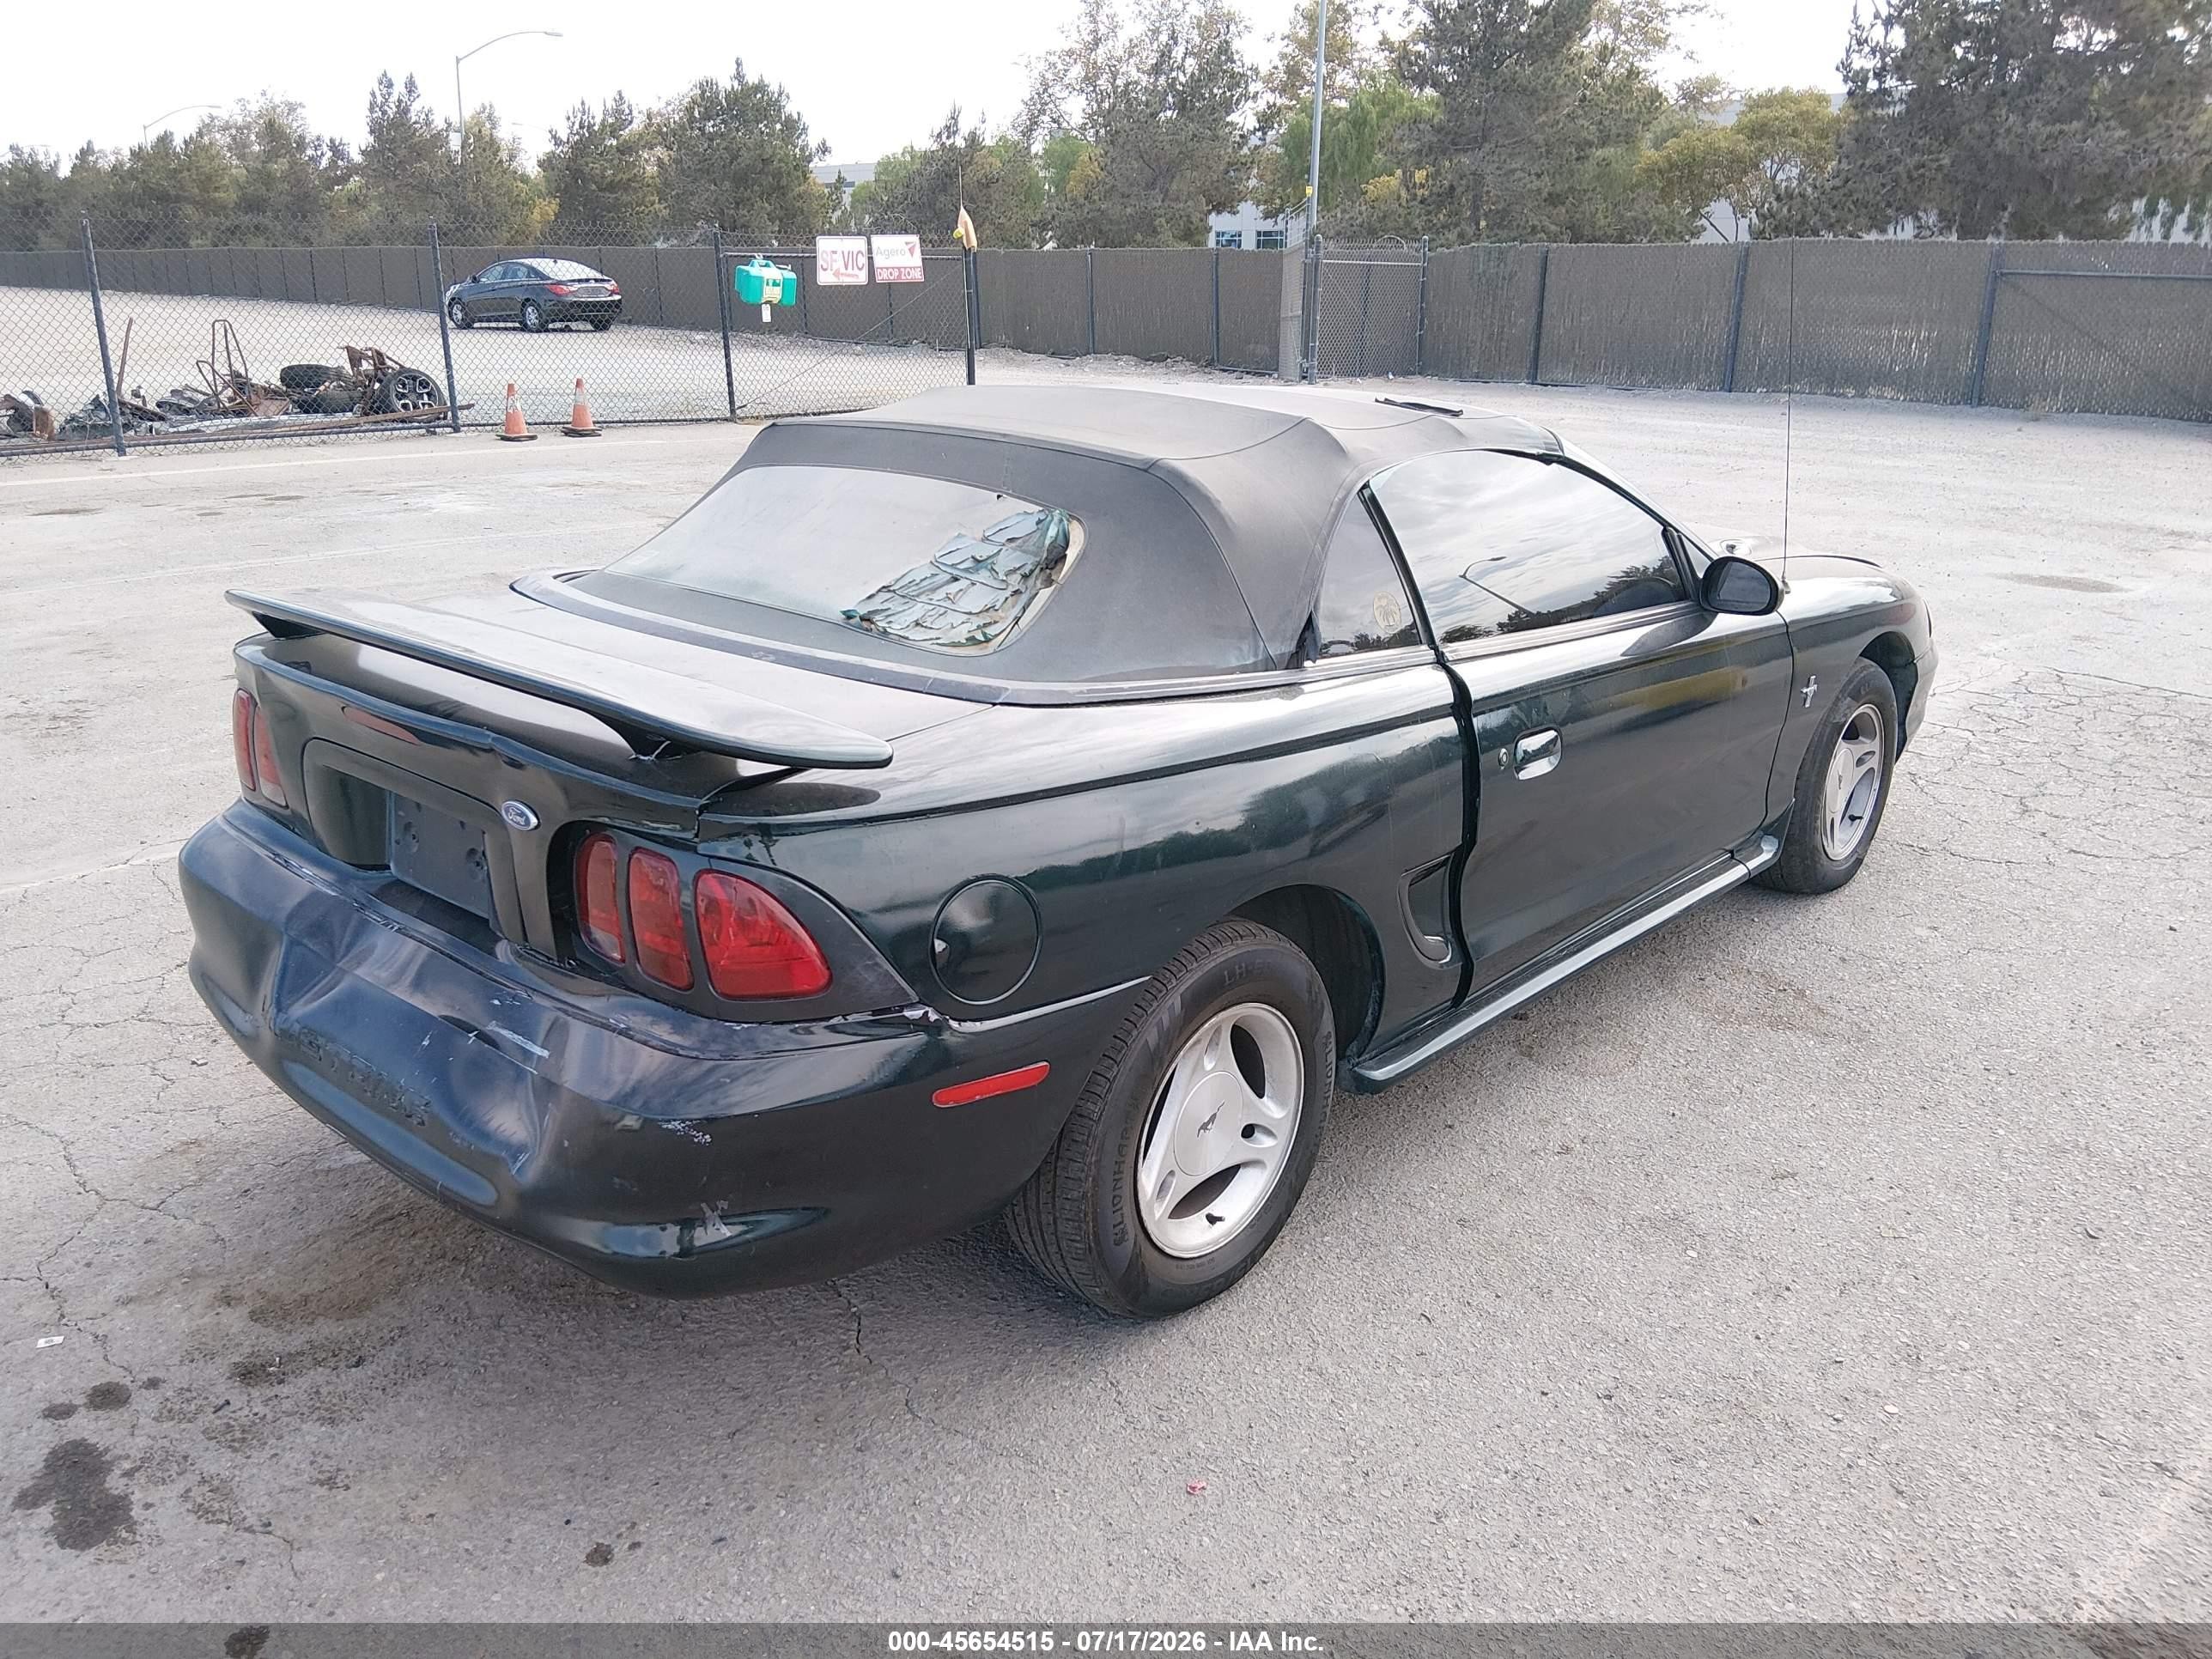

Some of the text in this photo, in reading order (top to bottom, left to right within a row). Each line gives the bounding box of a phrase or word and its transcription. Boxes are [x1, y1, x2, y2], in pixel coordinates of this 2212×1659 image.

[875, 246, 906, 259] Agero
[842, 250, 865, 271] VIC
[877, 268, 921, 280] DROP ZONE
